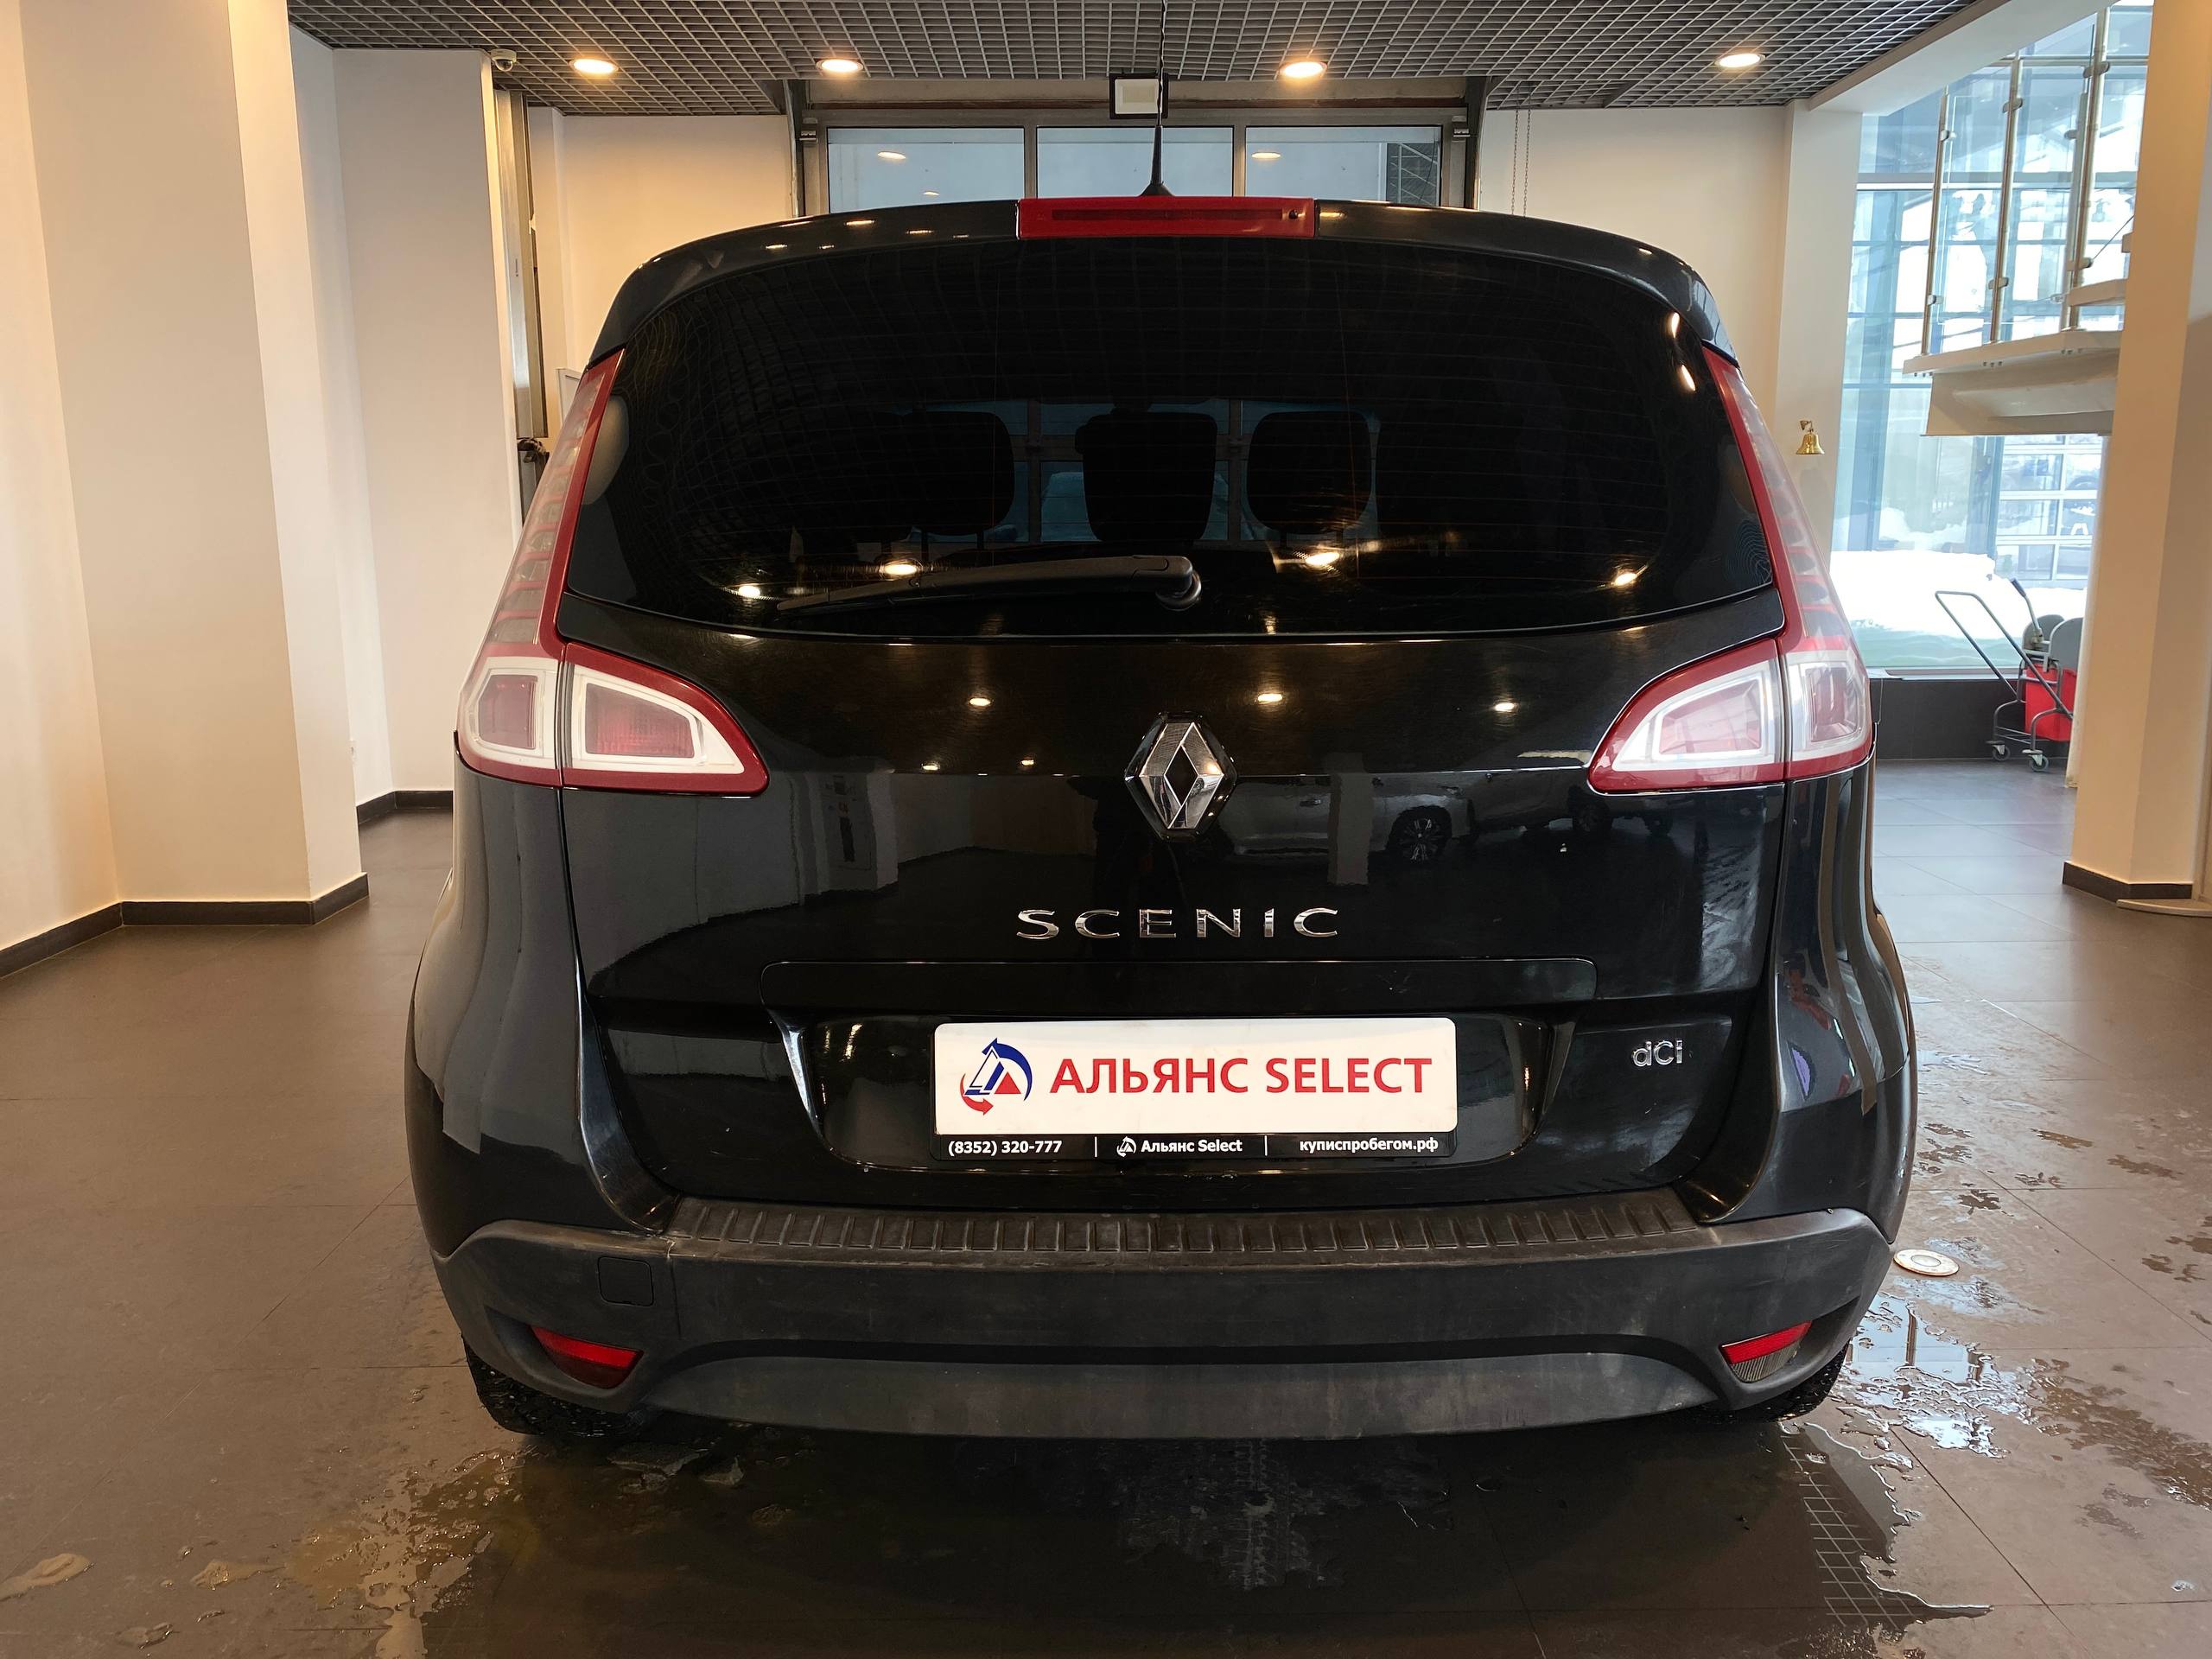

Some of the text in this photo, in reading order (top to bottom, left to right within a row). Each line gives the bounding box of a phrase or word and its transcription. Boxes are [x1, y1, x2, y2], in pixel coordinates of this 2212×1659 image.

[1016, 907, 1339, 939] SCENIC
[1632, 1039, 1683, 1067] dCi
[1050, 1058, 1433, 1094] АЛЬЯНС SELECT
[948, 1140, 1063, 1157] (8352) 320-777
[1141, 1139, 1243, 1154] Альянс Select
[1299, 1137, 1440, 1154] куписпробегом.рф
